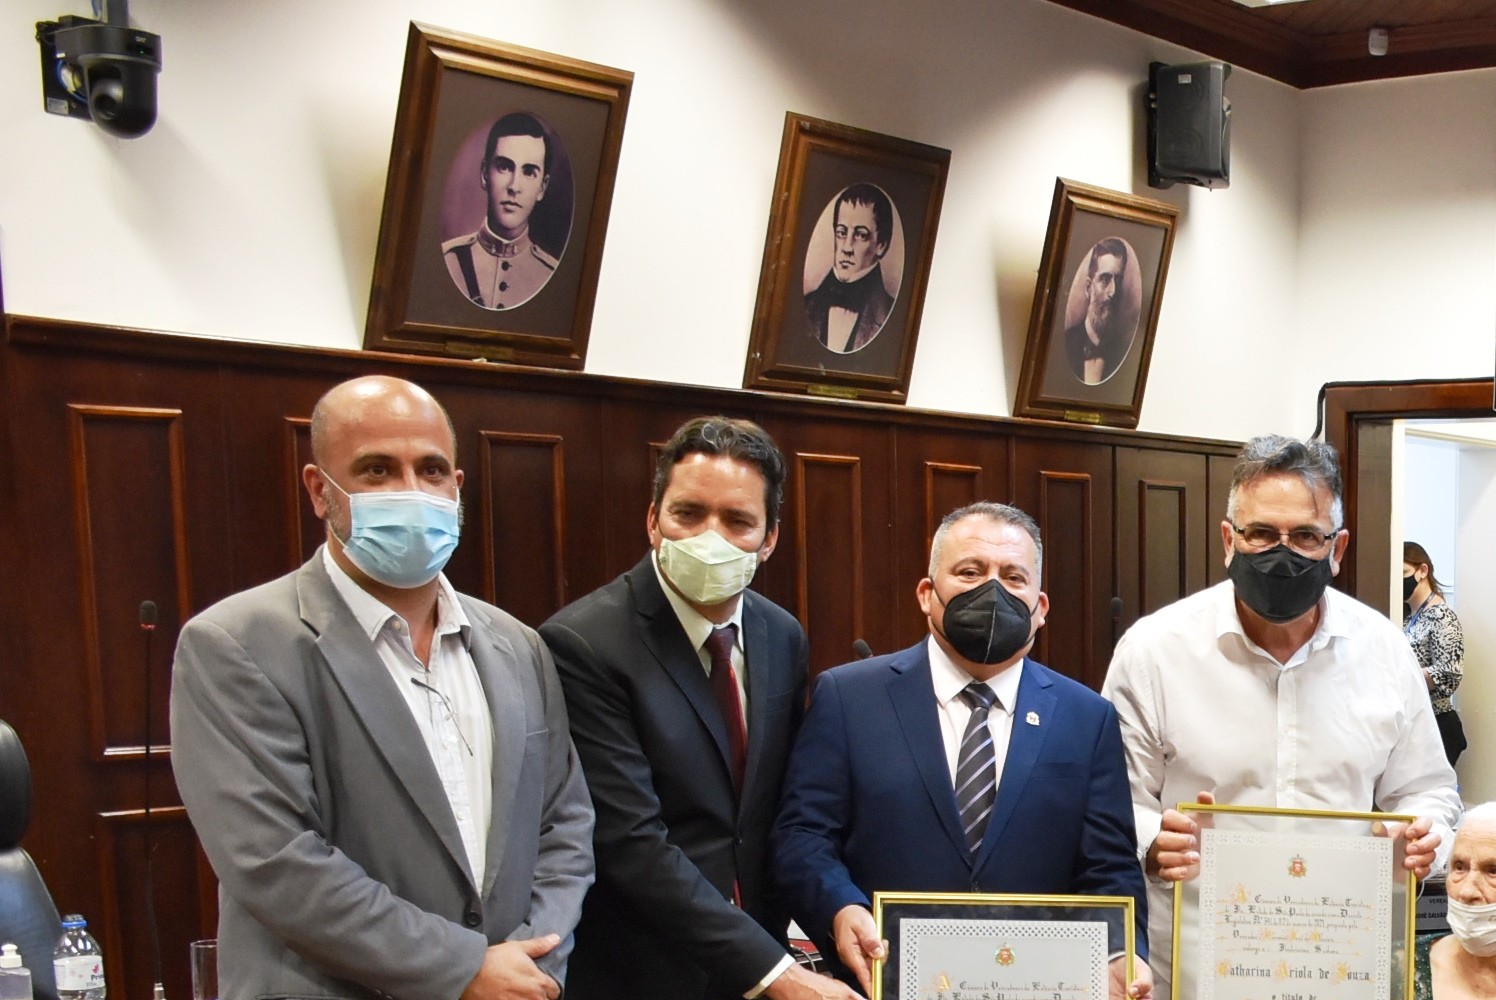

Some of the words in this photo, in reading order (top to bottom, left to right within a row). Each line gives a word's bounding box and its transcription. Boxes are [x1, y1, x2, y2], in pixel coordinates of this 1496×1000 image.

[1217, 961, 1271, 978] Catharina
[1276, 961, 1312, 979] Ariola
[1318, 967, 1329, 980] de
[1336, 963, 1369, 981] Souza
